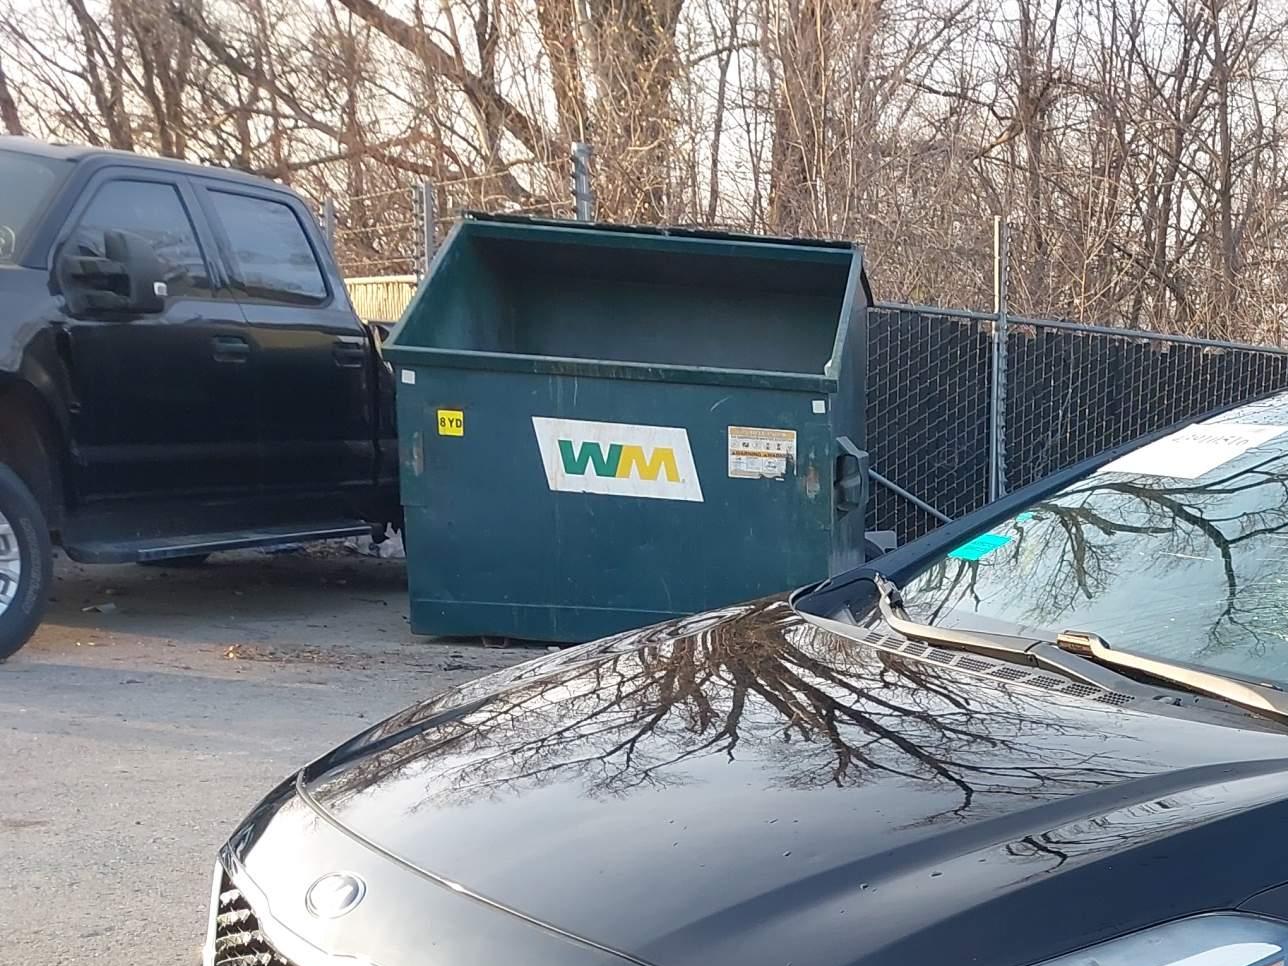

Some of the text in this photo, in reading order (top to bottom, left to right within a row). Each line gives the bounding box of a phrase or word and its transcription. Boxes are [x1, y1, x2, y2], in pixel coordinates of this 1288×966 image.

[440, 416, 462, 428] 8 YD
[557, 439, 681, 482] WM
